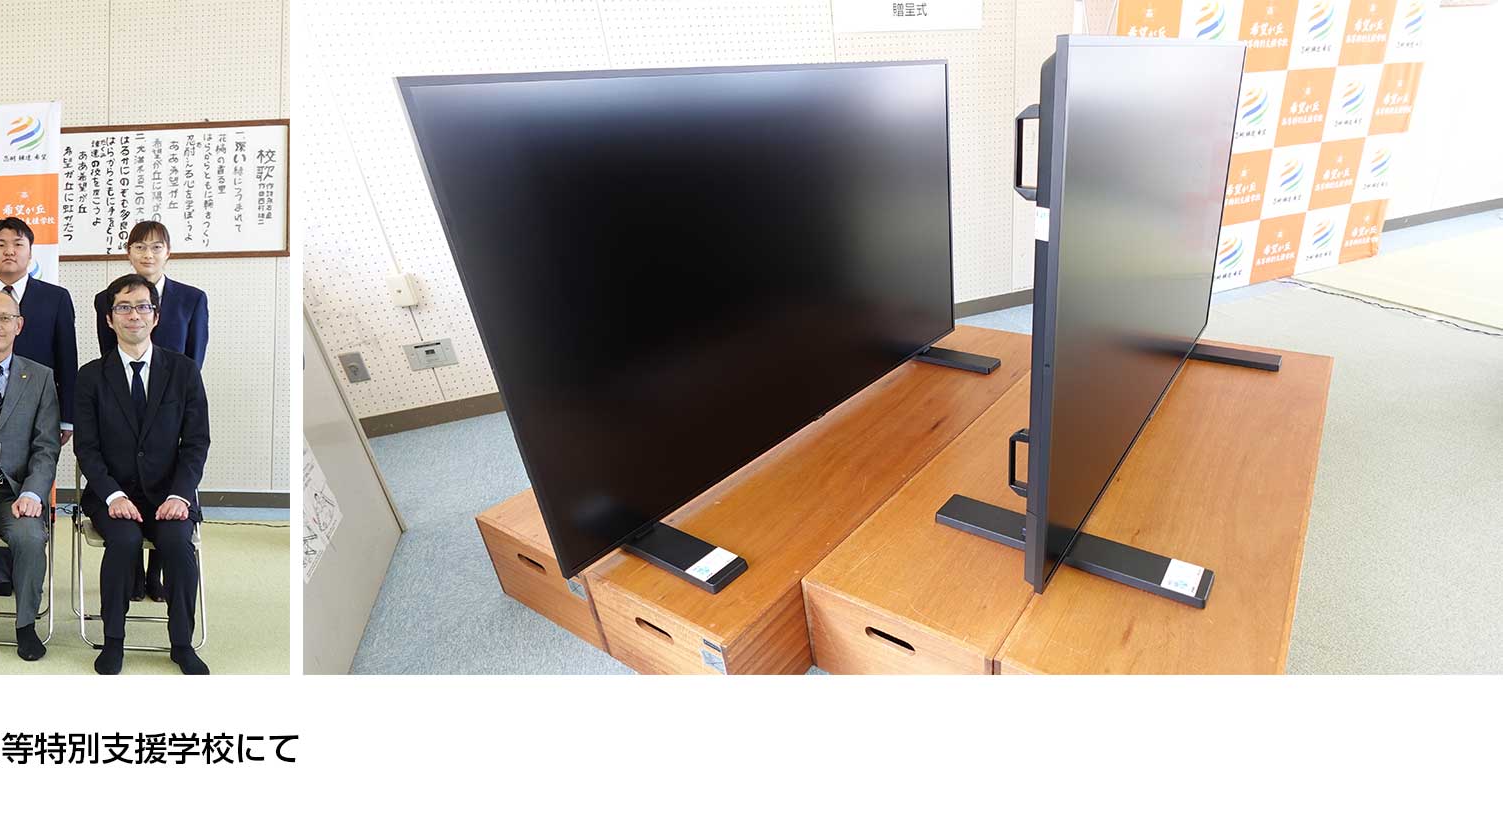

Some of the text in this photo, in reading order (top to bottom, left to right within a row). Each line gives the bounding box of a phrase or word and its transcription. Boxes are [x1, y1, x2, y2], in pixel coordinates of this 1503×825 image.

[892, 3, 928, 16] 贈呈式
[256, 149, 276, 182] 校歌
